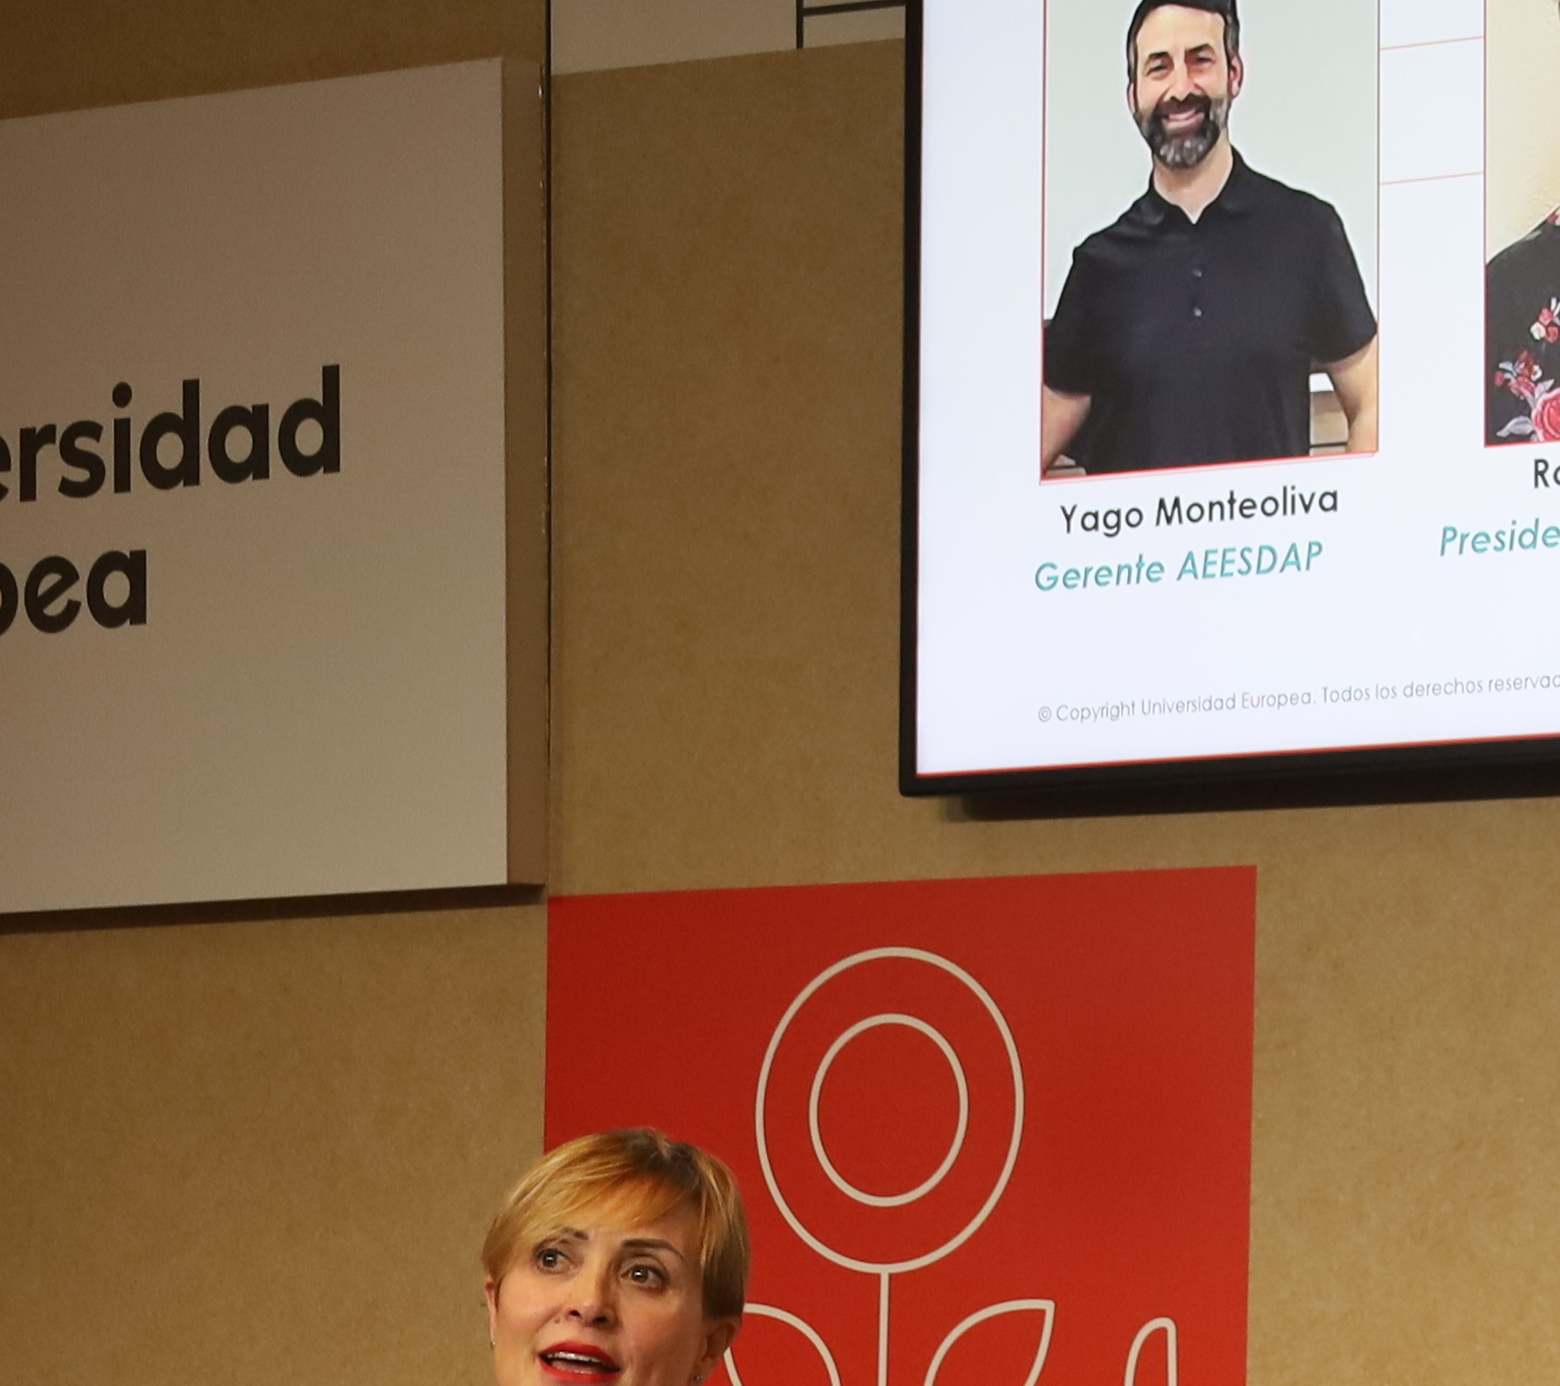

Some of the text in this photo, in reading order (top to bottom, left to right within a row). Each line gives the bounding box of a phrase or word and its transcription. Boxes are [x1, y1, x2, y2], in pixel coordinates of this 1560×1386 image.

[1060, 485, 1339, 539] Yago Monteoliva
[1035, 540, 1323, 592] Gerente AEESDAP
[1056, 700, 1137, 723] Copyright
[1141, 694, 1236, 715] Universidad
[1242, 688, 1315, 711] Europea.
[1322, 683, 1370, 704] Todos
[1375, 682, 1397, 700] los
[1402, 675, 1483, 698] derechos
